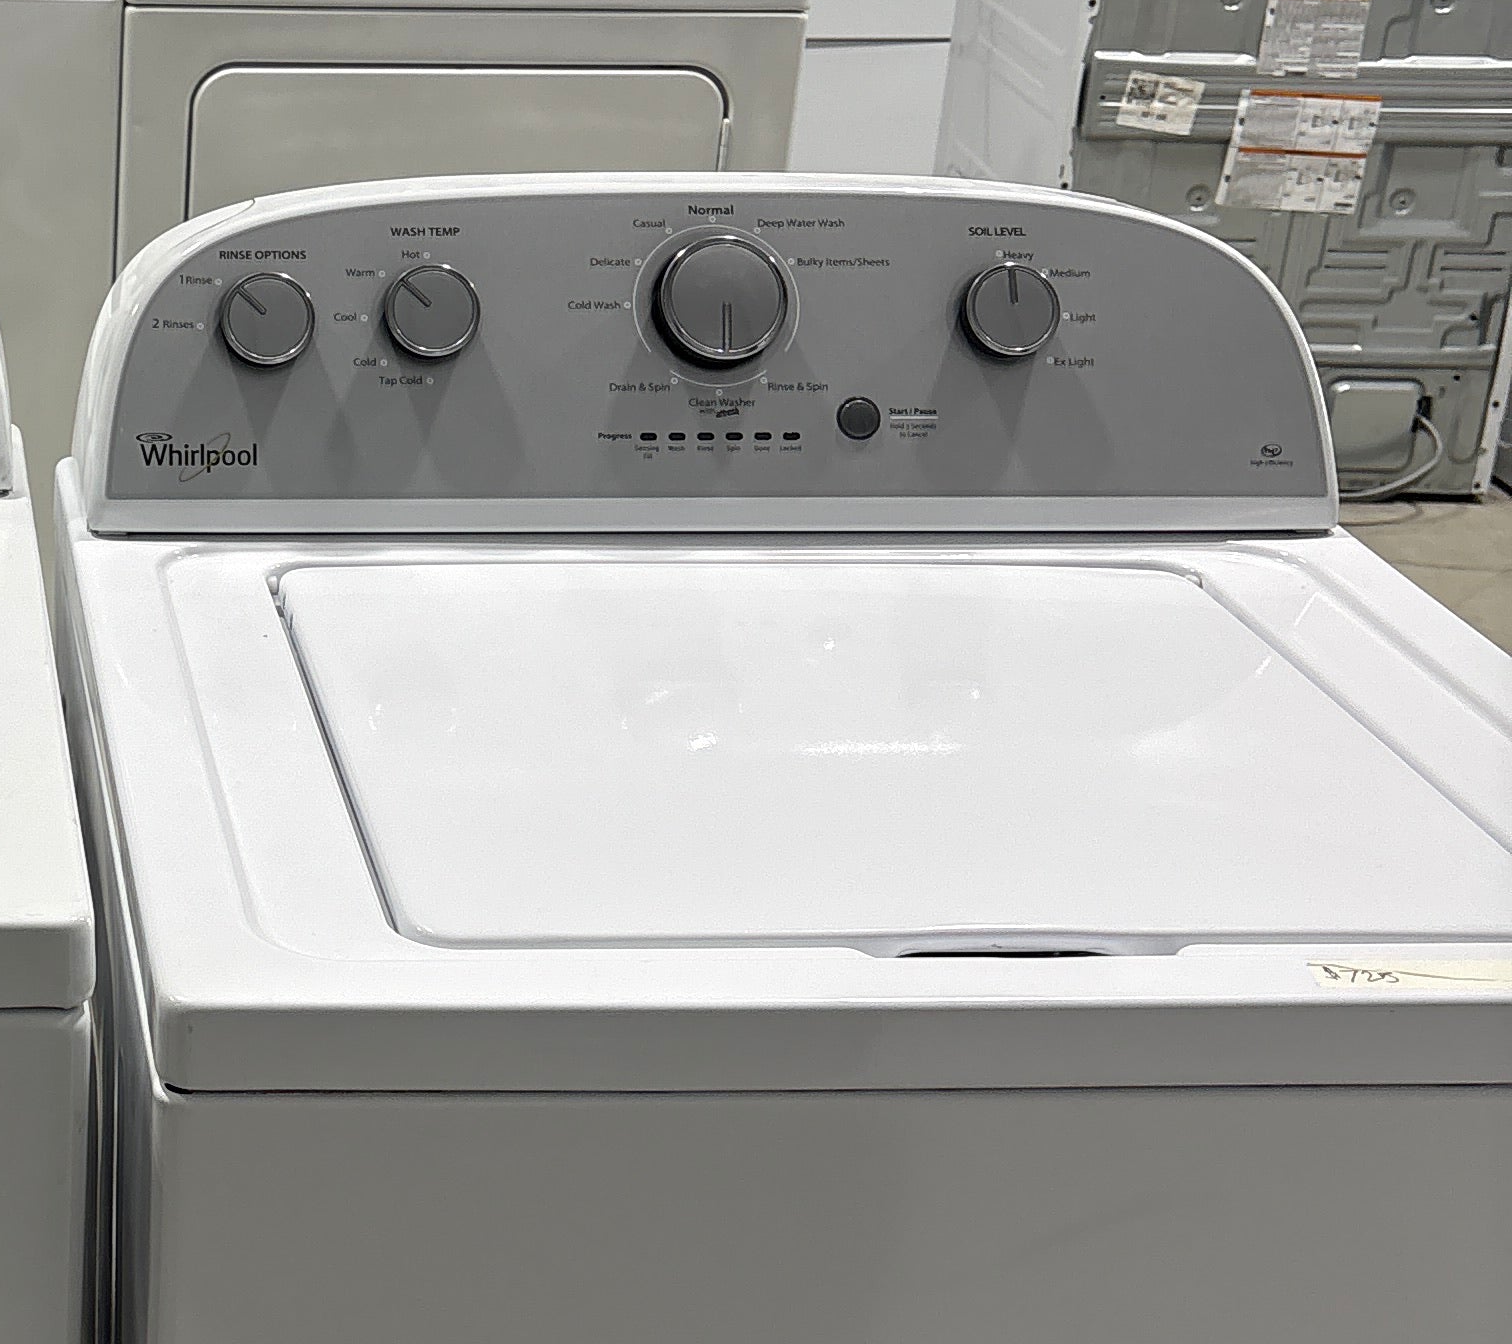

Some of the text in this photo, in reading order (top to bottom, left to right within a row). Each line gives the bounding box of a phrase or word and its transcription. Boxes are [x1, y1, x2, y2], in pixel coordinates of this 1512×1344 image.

[688, 204, 735, 216] Normal
[632, 218, 666, 229] Casual
[757, 218, 845, 230] Deep Water Wash
[390, 227, 460, 237] WASH TEMP
[968, 226, 1026, 237] SOIL LEVEL
[219, 250, 307, 260] RINSE OPTIONS
[401, 250, 420, 260] Hot
[1003, 250, 1034, 262] Heavy
[590, 257, 631, 267] Delicate
[797, 257, 890, 269] Bulky Items/Sheets
[345, 268, 376, 278] Warm
[1049, 268, 1091, 278] Medium
[567, 300, 621, 310] Cold Wash
[334, 312, 358, 323] Cool
[1071, 312, 1096, 324] Light
[152, 318, 194, 329] 2 Rinses
[353, 357, 377, 367] Cold
[1054, 357, 1095, 369] Ex Light
[379, 376, 423, 387] Tap Cold
[609, 381, 671, 395] Drain & Spin
[768, 381, 828, 394] Rinse & Spin
[688, 397, 755, 407] Clean Washer
[598, 431, 632, 441] Progress
[140, 441, 258, 475] Whirlpool
